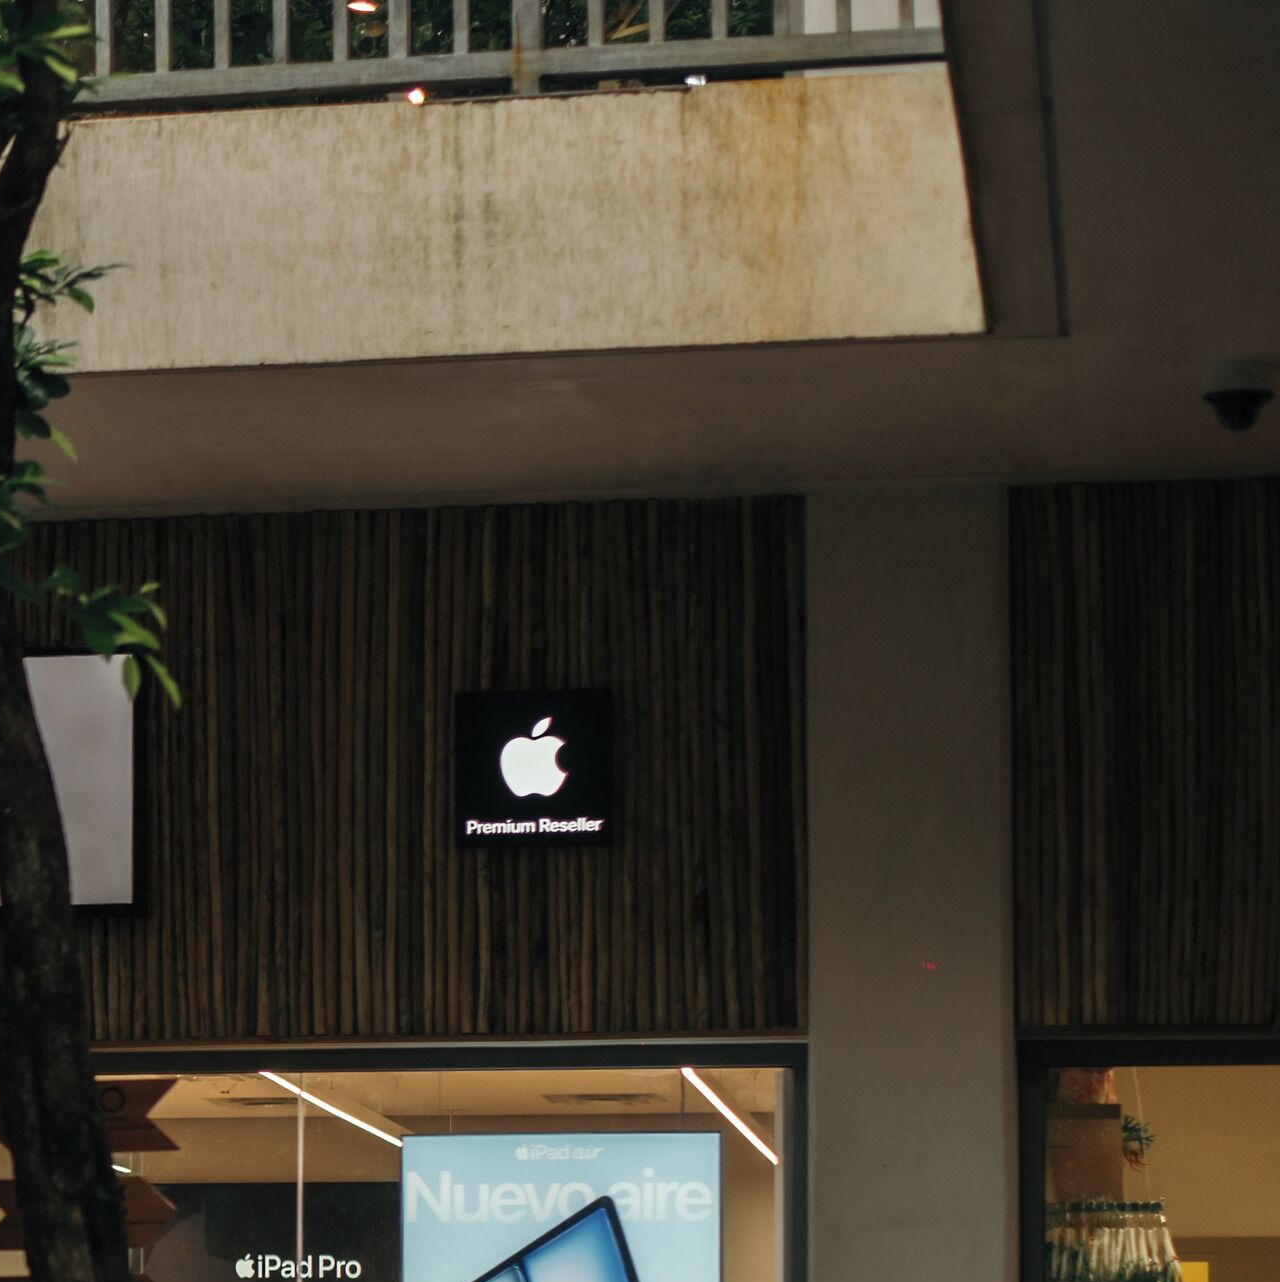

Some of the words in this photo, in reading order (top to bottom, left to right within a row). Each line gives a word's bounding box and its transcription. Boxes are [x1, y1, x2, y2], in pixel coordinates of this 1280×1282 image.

[466, 819, 536, 835] Premium
[539, 817, 604, 833] Reseller
[531, 1144, 571, 1160] iPad
[406, 1170, 595, 1223] Nuevo
[607, 1167, 713, 1223] aire
[258, 1254, 313, 1278] iPad
[319, 1254, 362, 1279] Pro
